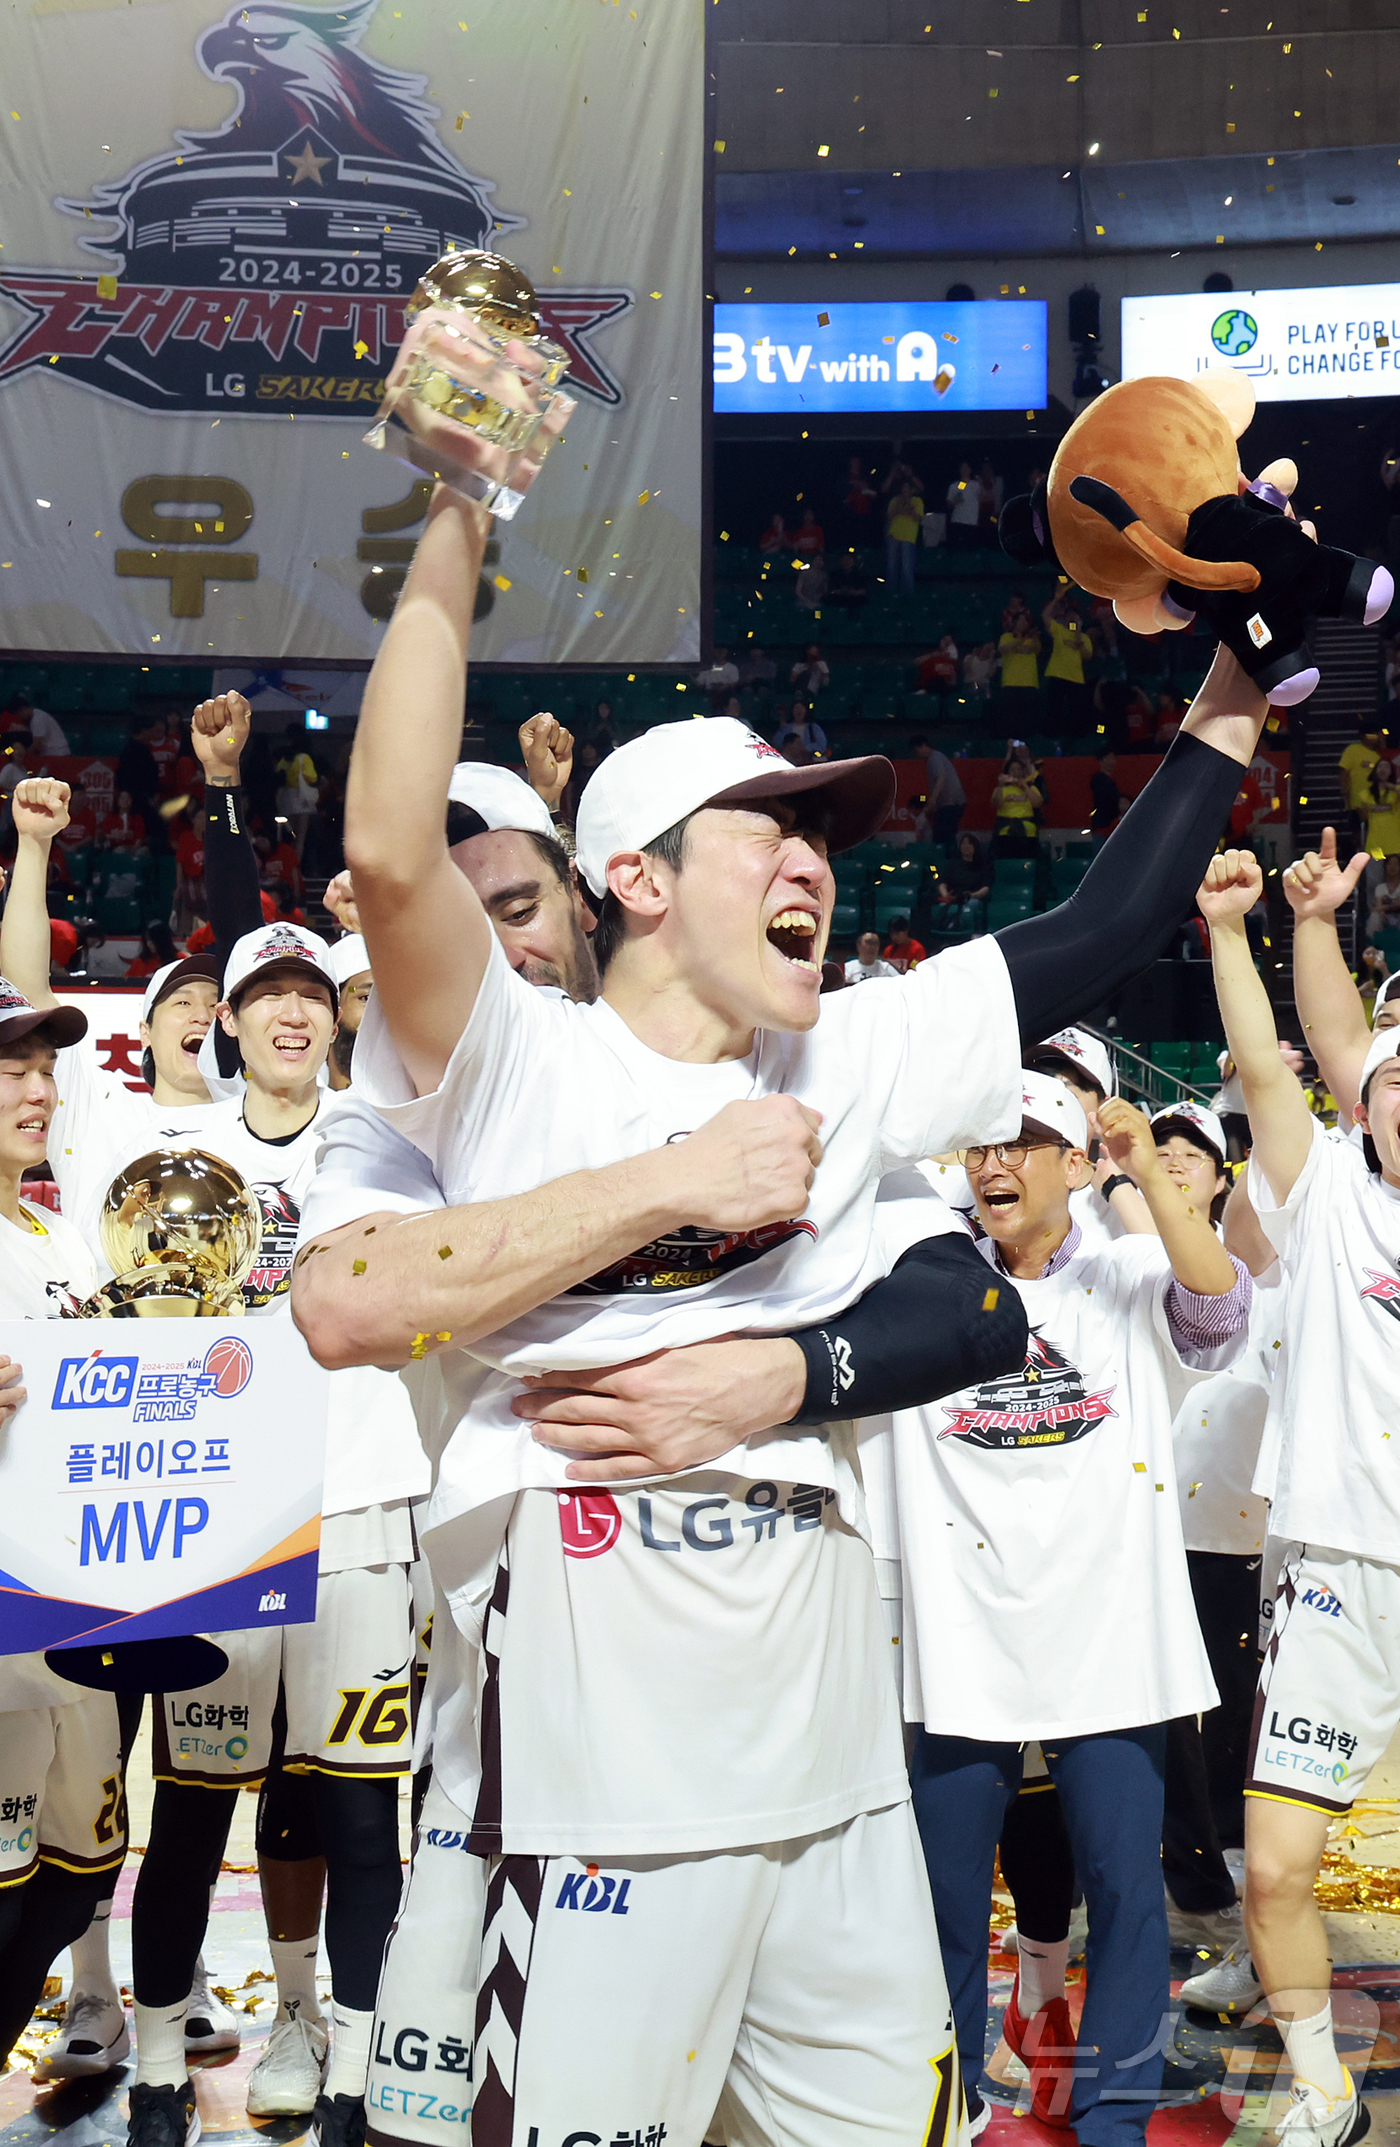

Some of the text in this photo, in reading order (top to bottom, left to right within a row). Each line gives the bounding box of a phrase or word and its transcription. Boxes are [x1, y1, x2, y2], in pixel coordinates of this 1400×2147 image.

[218, 257, 402, 288] 2024-2025
[1288, 323, 1338, 345] PLAY
[1345, 320, 1386, 343] FOR
[820, 353, 890, 382] with
[1288, 350, 1400, 375] CHANGE FO
[205, 372, 386, 403] LG SAKER
[622, 1273, 647, 1287] LG
[59, 1352, 131, 1405] KCC
[142, 1362, 185, 1371] 2024-2025
[137, 1373, 219, 1399] 프로농구
[133, 1400, 198, 1423] FINALS
[938, 1386, 1118, 1438] CHAMPIONS
[1005, 1396, 1060, 1412] 2024-2025
[1001, 1431, 1066, 1446] LG SAKERS
[66, 1438, 231, 1484] 플레이오프
[79, 1497, 210, 1567] MVP
[637, 1481, 835, 1553] LG유플
[258, 1592, 287, 1613] KBL
[1302, 1588, 1343, 1618] KBL
[171, 1700, 249, 1731] LG화학
[324, 1682, 411, 1748] 16
[1269, 1711, 1358, 1761] LG화학
[0, 1793, 38, 1824] 화학
[555, 1870, 632, 1915] KBL
[374, 2021, 474, 2082] LG화
[369, 2081, 473, 2124] LETZer
